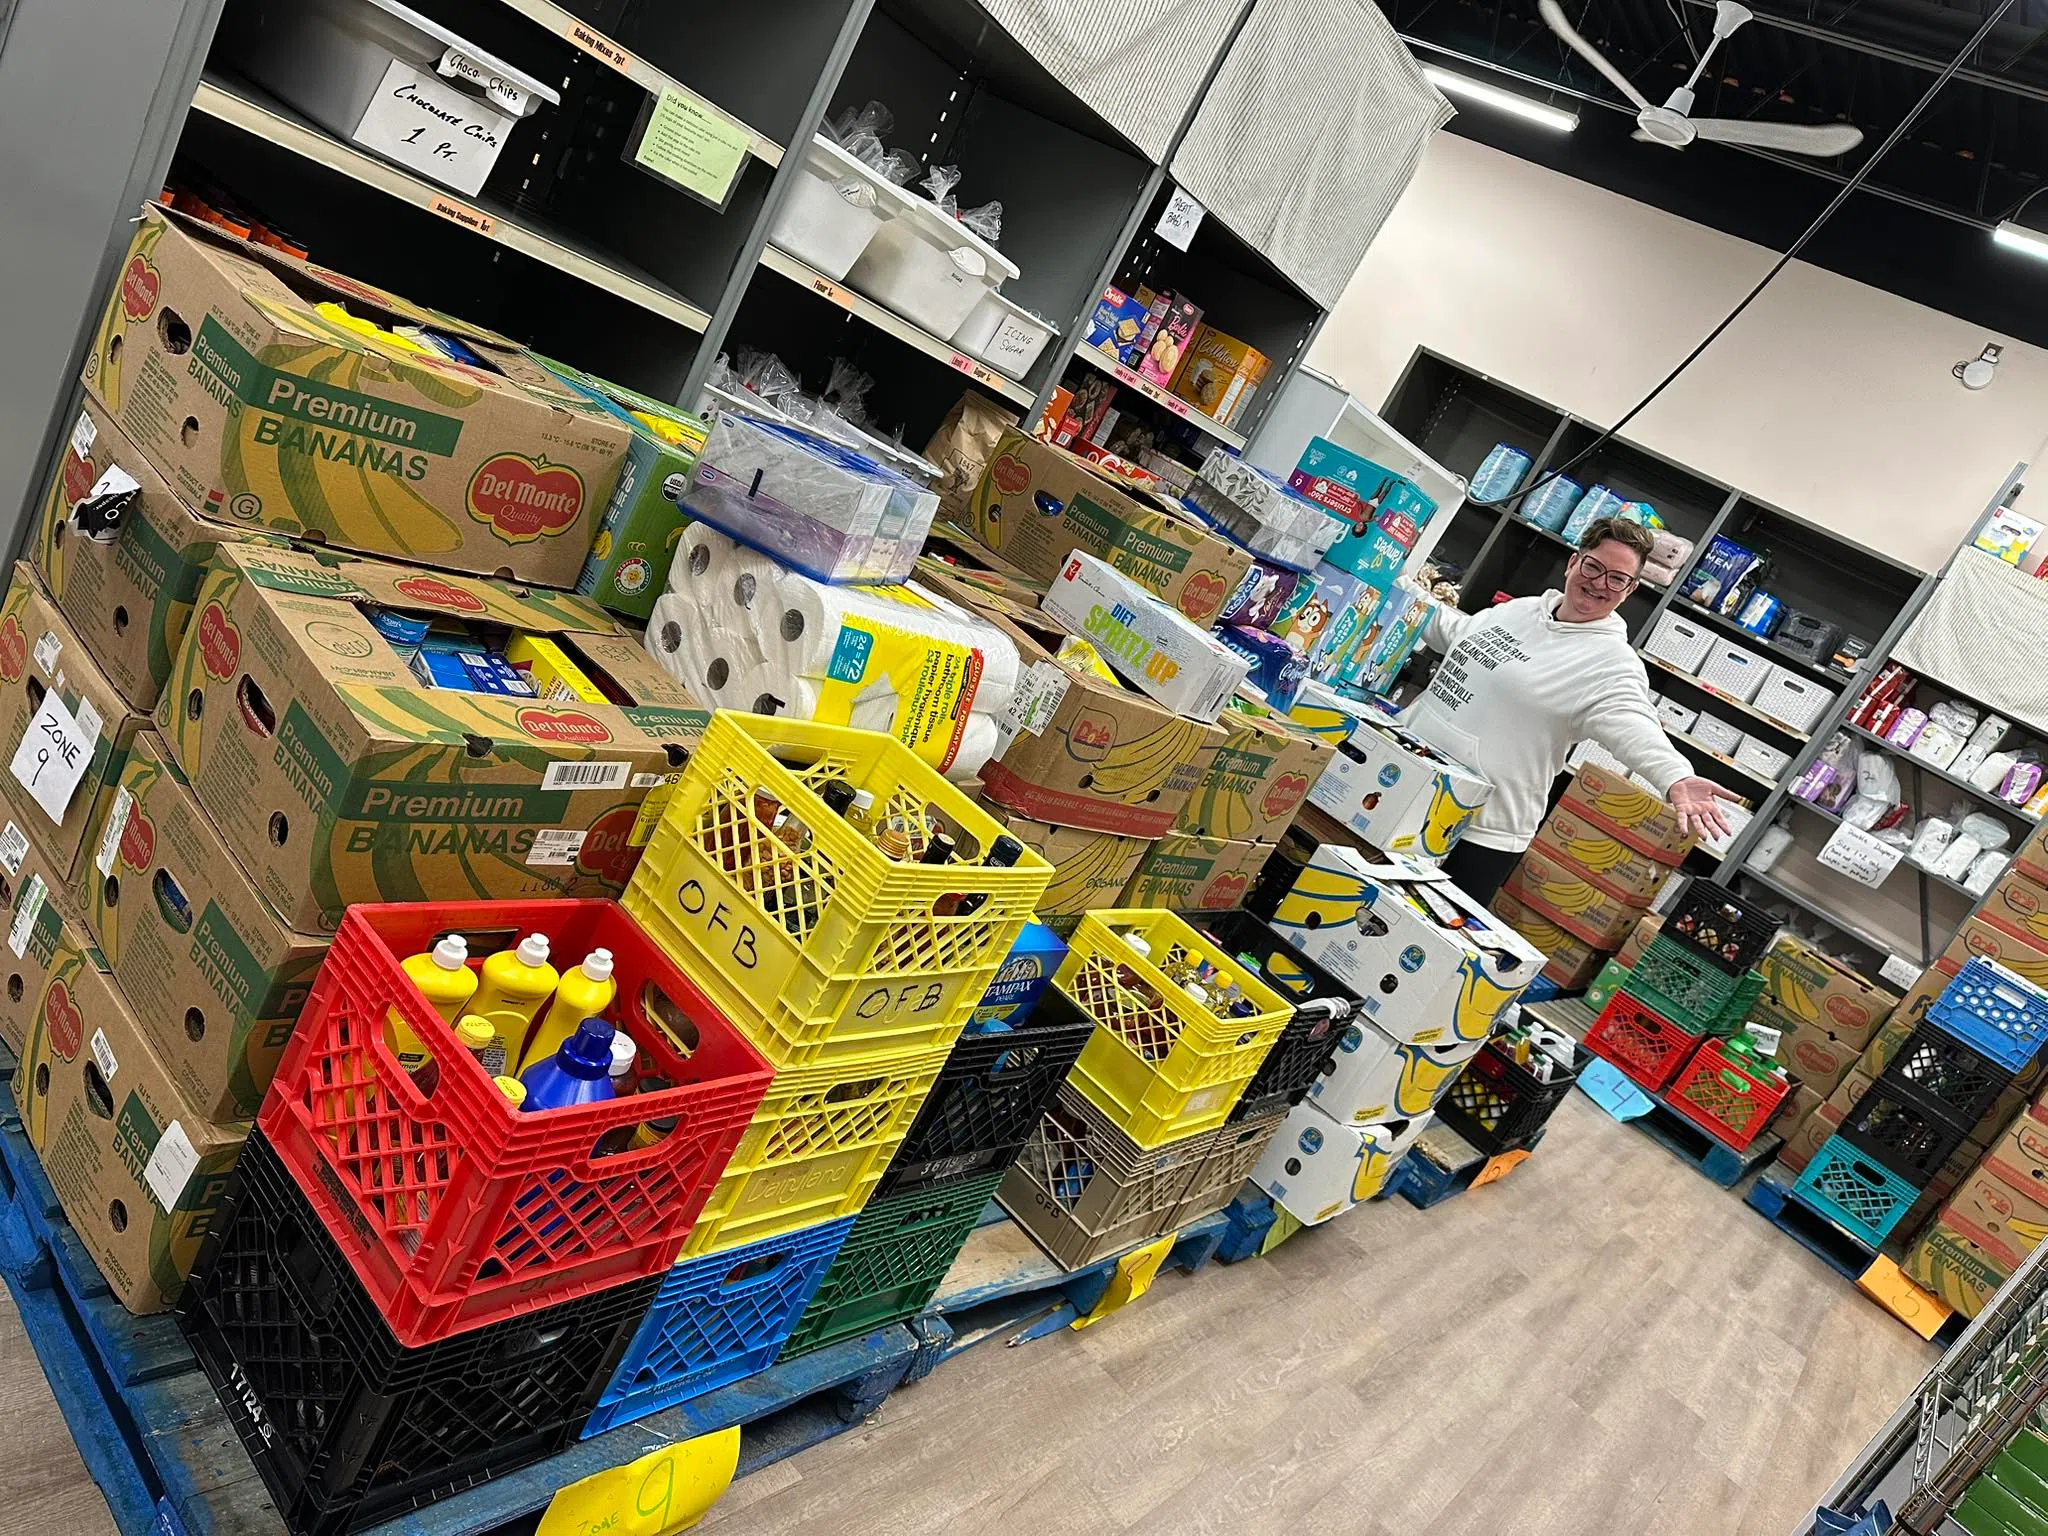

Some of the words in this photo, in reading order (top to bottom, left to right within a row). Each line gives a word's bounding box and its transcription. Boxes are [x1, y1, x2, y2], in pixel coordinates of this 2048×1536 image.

[574, 27, 595, 49] Baking
[594, 39, 613, 59] Mixes
[488, 76, 519, 102] Chips
[666, 94, 678, 105] Did
[677, 101, 689, 112] you
[393, 84, 461, 126] CHOCOLATE
[401, 127, 426, 145] 1
[436, 203, 457, 220] Baking
[456, 211, 478, 228] Supplies
[999, 339, 1025, 356] SUGAR
[1003, 325, 1034, 345] ICING
[198, 334, 241, 388] Premium
[187, 357, 242, 418] BANANAS
[267, 377, 418, 442] Premium
[255, 416, 430, 481] BANANAS
[480, 473, 513, 499] Del
[515, 480, 577, 514] Monte
[1323, 496, 1352, 515] cruisers
[500, 504, 542, 525] Quality
[1070, 505, 1110, 536] Premium
[1062, 519, 1110, 554] BANANAS
[1124, 531, 1175, 564] Premium
[123, 528, 165, 583] Premium
[1112, 553, 1171, 588] BANANAS
[1705, 553, 1733, 571] MEN
[1226, 572, 1260, 618] Royale
[1110, 603, 1137, 628] DIET
[202, 611, 215, 635] Del
[213, 630, 236, 667] Monte
[857, 634, 867, 651] 24
[1083, 604, 1151, 668] SPRITZ
[1145, 650, 1179, 686] UP
[1485, 646, 1513, 663] VALLEY
[847, 658, 864, 680] 72
[927, 650, 941, 689] papier
[972, 659, 982, 683] CLUB
[1451, 649, 1468, 667] MONO
[1457, 640, 1499, 671] MELANCTHON
[935, 654, 954, 708] bathroom
[945, 668, 958, 700] triple
[1435, 671, 1474, 704] ORANGEVILLE
[1443, 660, 1468, 684] MULMUR
[911, 664, 928, 713] rouleaux
[965, 683, 976, 706] SIZE
[1429, 681, 1461, 712] SHELBURNE
[525, 719, 550, 734] Del
[552, 720, 604, 735] Monte
[631, 713, 709, 728] Premium
[922, 708, 938, 743] tissue
[937, 701, 950, 725] rolls
[953, 709, 967, 746] FORMAT
[40, 712, 81, 770] ZONE
[1075, 719, 1110, 744] Dole
[32, 748, 50, 787] 9
[282, 721, 333, 797] Premium
[943, 746, 957, 767] CLUB
[1214, 752, 1260, 772] Premium
[273, 743, 335, 828] BANANAS
[1201, 773, 1256, 794] BANANAS
[361, 788, 523, 818] Premium
[346, 828, 537, 854] BANANAS
[593, 830, 623, 851] Del
[1151, 858, 1196, 876] Premium
[1138, 879, 1194, 897] BANANAS
[2010, 890, 2036, 907] Dole
[679, 880, 759, 969] OFB
[200, 920, 250, 998] Premium
[1971, 935, 1997, 952] Dole
[1774, 951, 1815, 980] Premium
[856, 983, 943, 1018] OFB
[985, 980, 1034, 998] TAMPAX
[59, 1008, 79, 1050] Monte
[748, 1162, 850, 1203] Dairyland
[1035, 1193, 1061, 1217] OFB
[1925, 1246, 1987, 1293] BANANAS
[1934, 1236, 1986, 1277] Premium
[635, 1456, 676, 1532] 9
